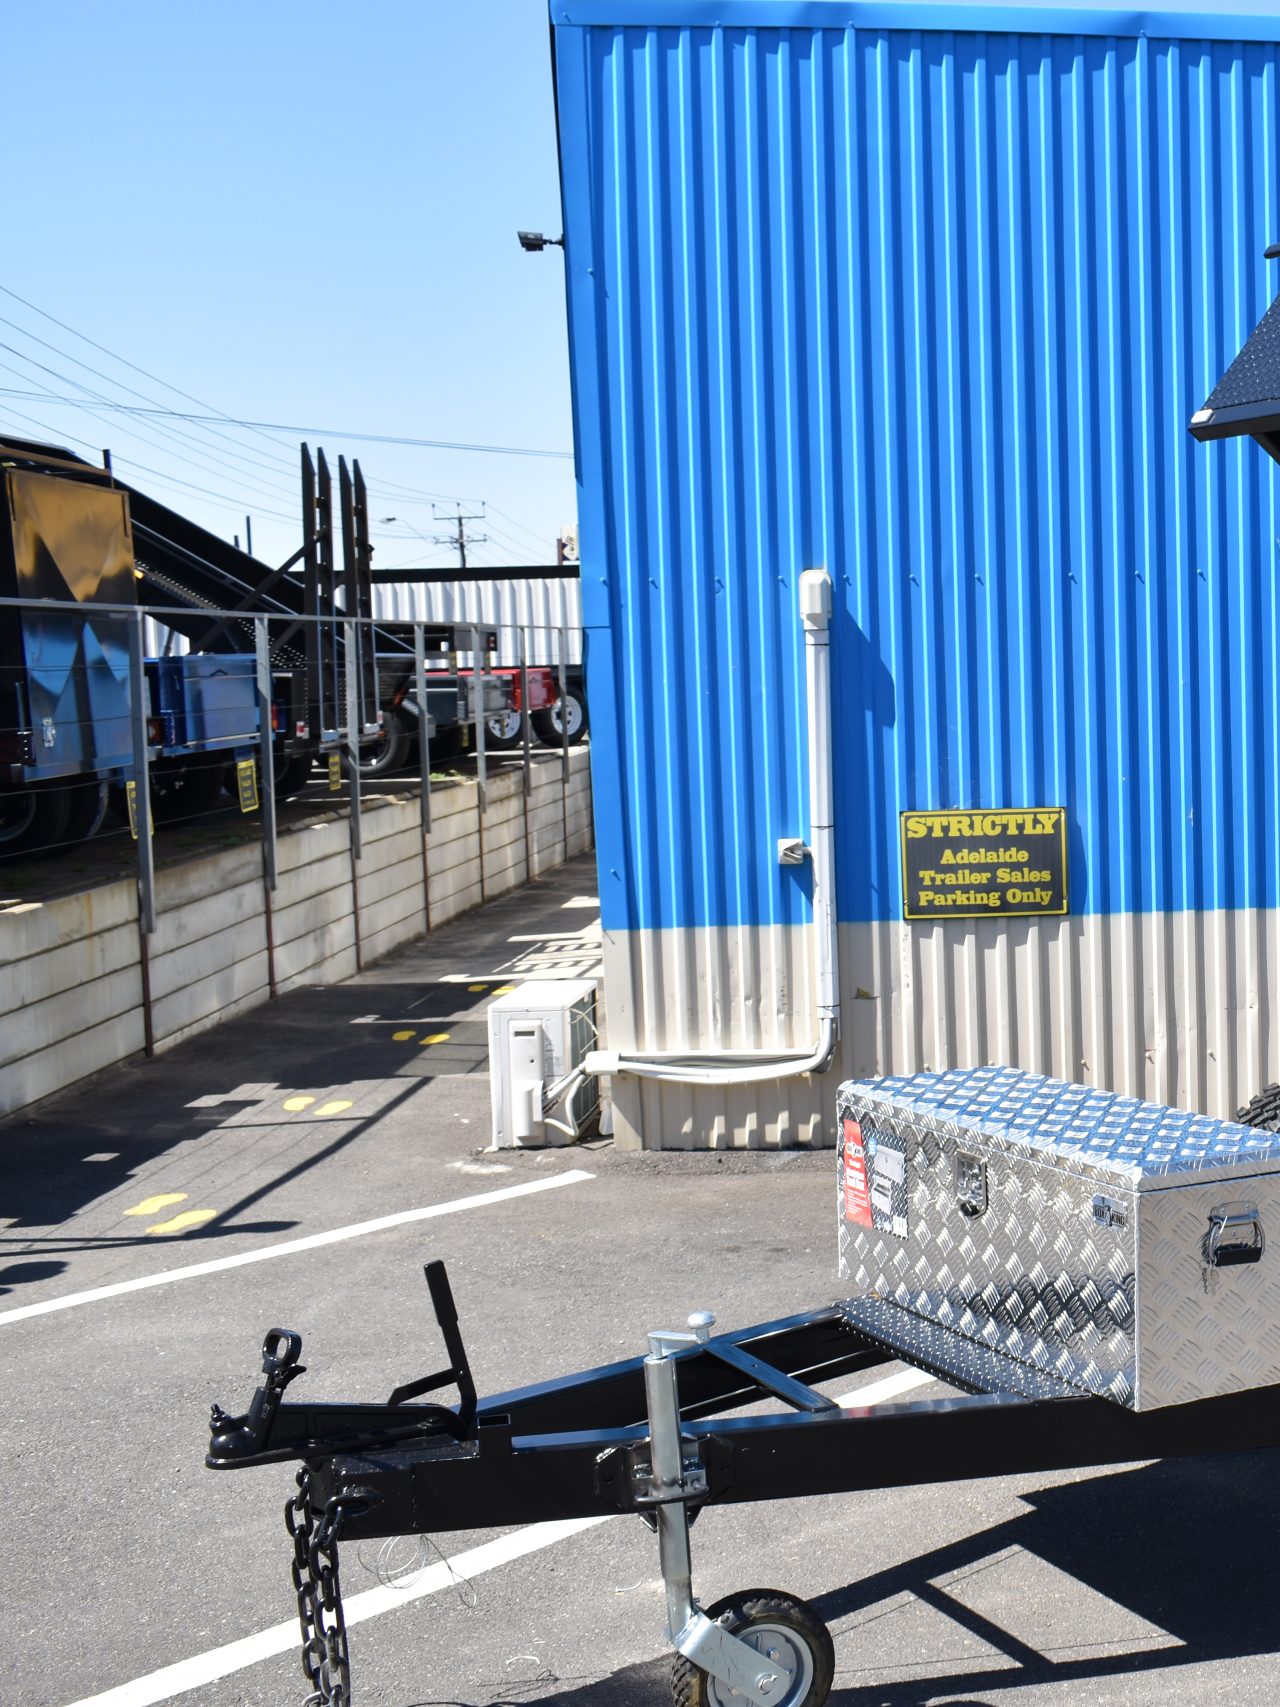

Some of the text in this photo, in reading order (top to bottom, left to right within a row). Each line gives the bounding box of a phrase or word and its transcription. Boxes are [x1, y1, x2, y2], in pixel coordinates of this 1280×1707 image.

[906, 813, 1060, 838] STRICTLY
[940, 847, 1029, 864] Adelaide
[919, 867, 1051, 885] Trailer Sales
[919, 887, 1053, 907] Parking Only
